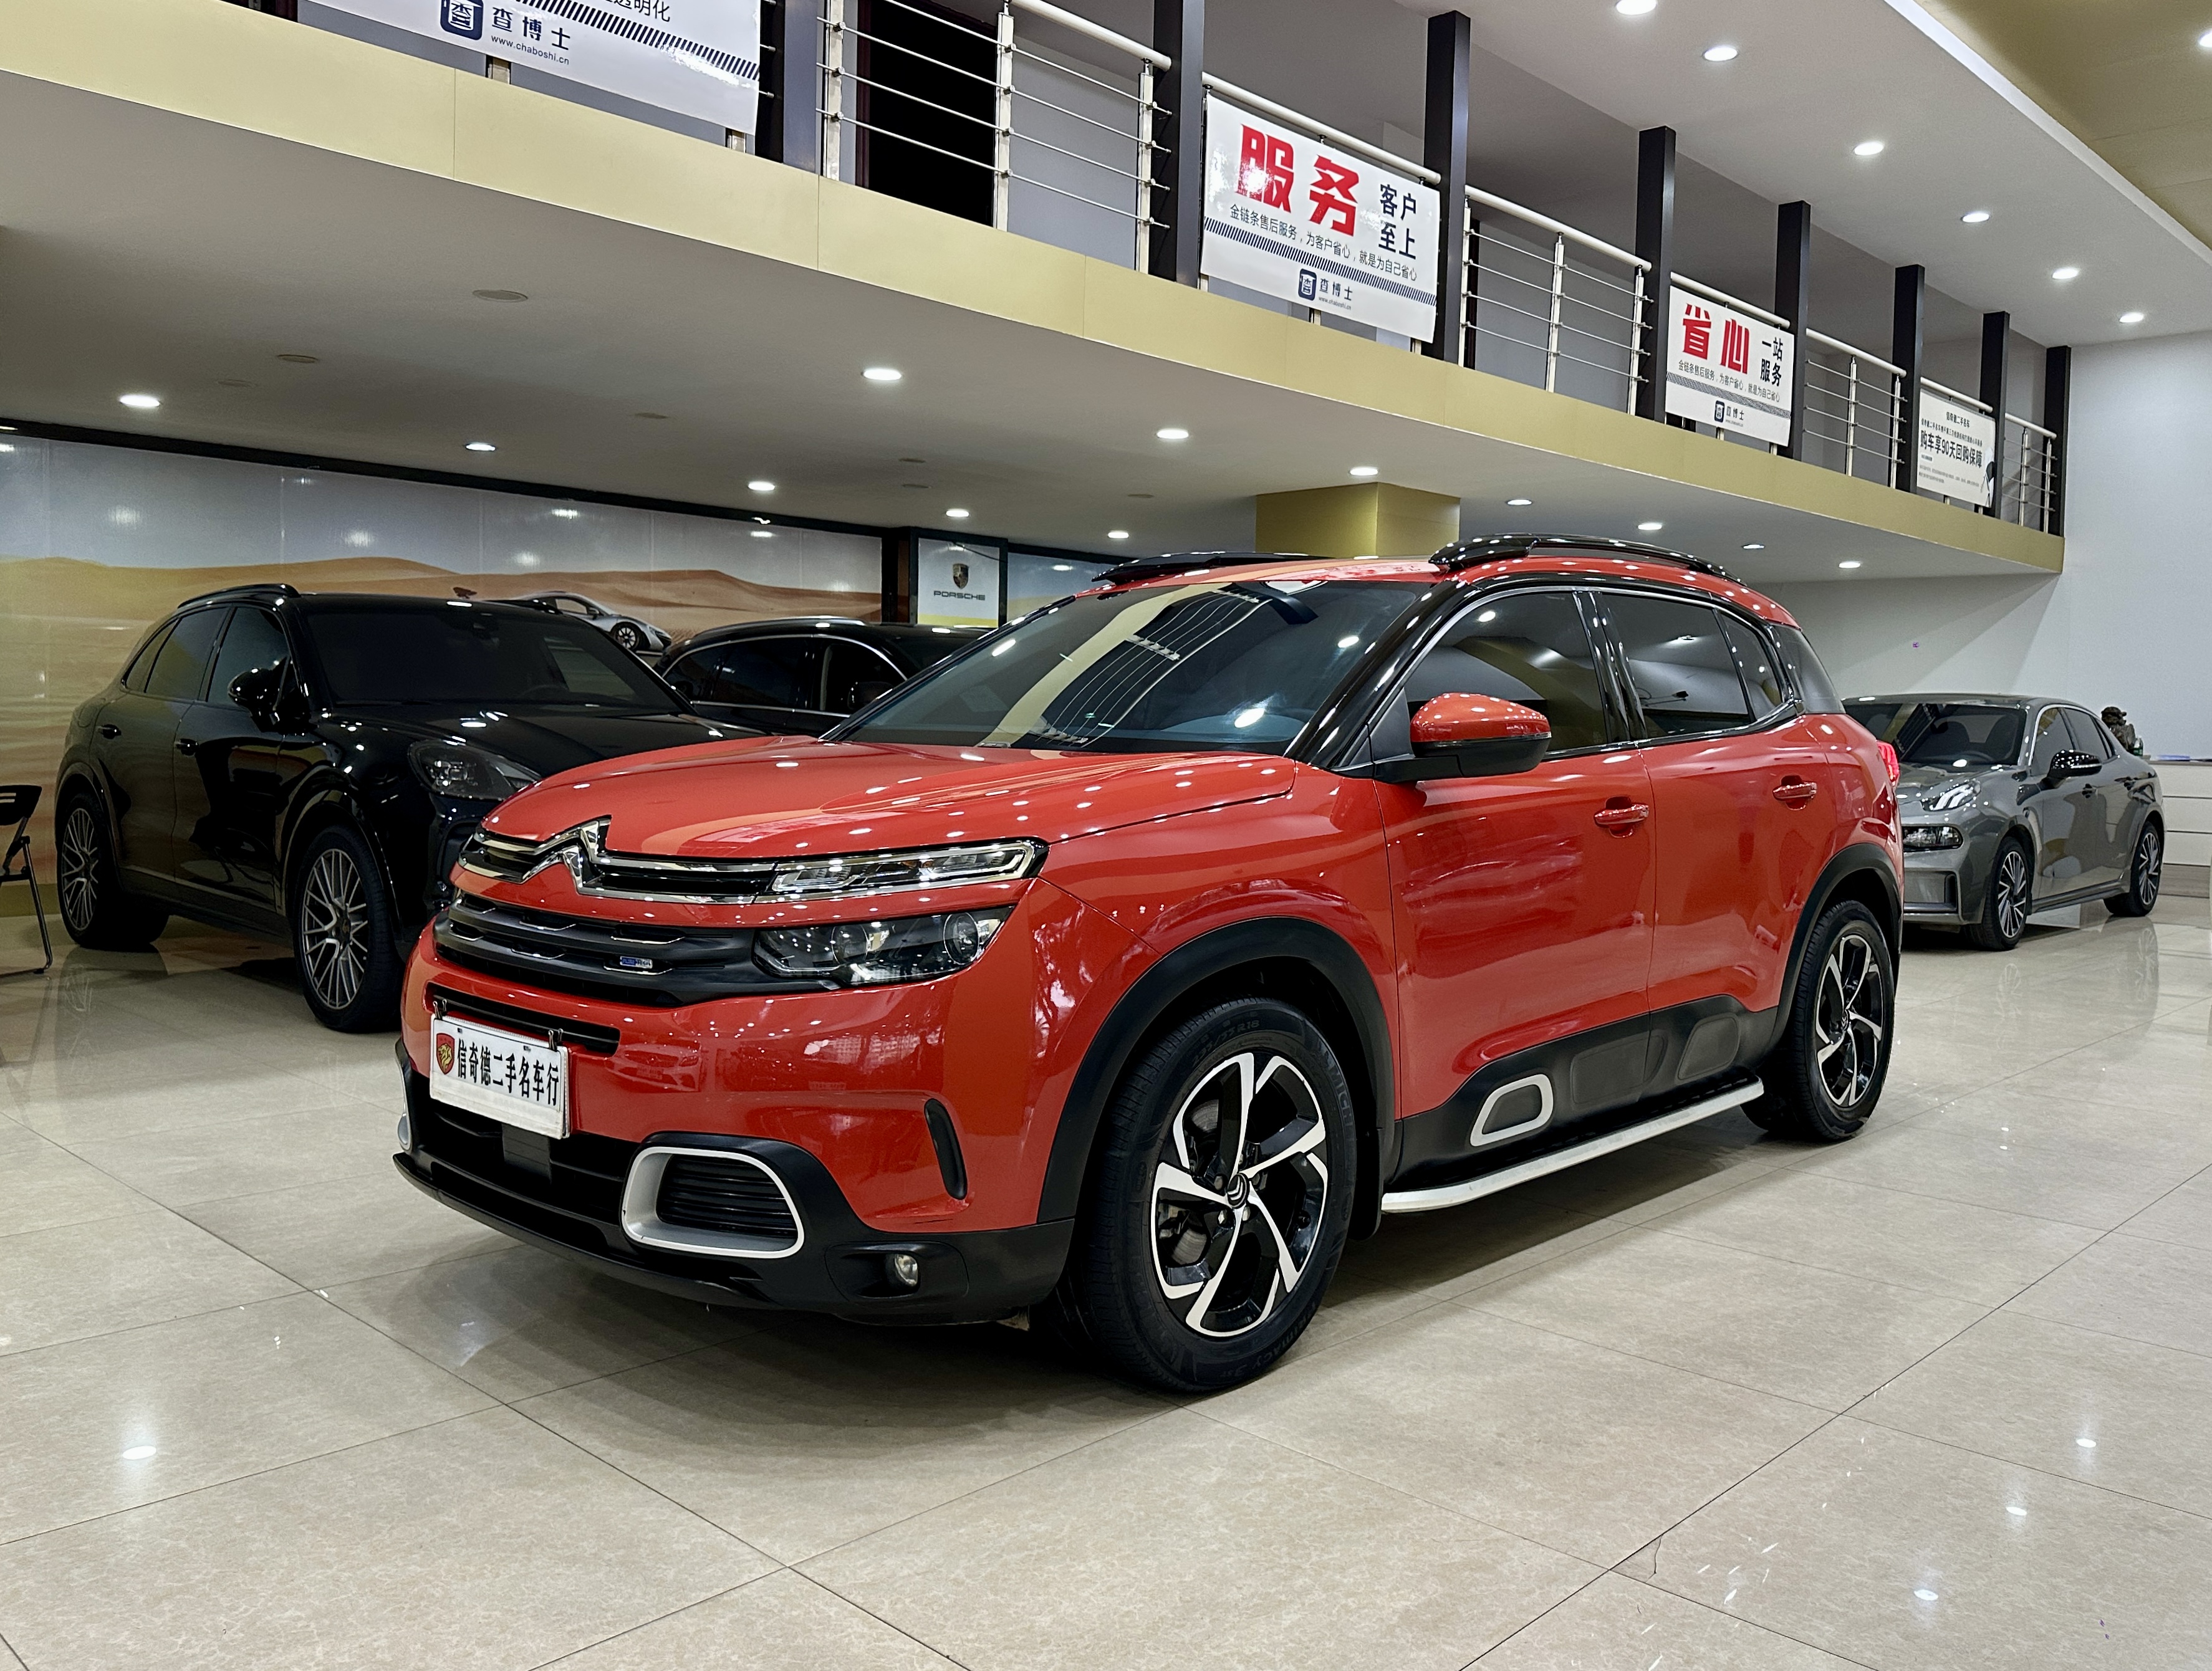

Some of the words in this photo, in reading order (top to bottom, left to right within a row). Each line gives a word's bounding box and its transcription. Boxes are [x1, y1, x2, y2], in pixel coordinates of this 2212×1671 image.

[492, 7, 570, 50] 查博士
[491, 35, 569, 65] www.chaboshi.cn
[1235, 124, 1360, 237] 服务
[1380, 184, 1417, 221] 客户
[1378, 223, 1416, 260] 至上
[1320, 278, 1353, 301] 查博士
[1682, 303, 1749, 375] 省心
[1762, 337, 1783, 361] 一站
[1760, 358, 1782, 386] 服务
[933, 590, 986, 601] PORSCHE
[458, 1038, 559, 1106] 信奇德二手名车行
